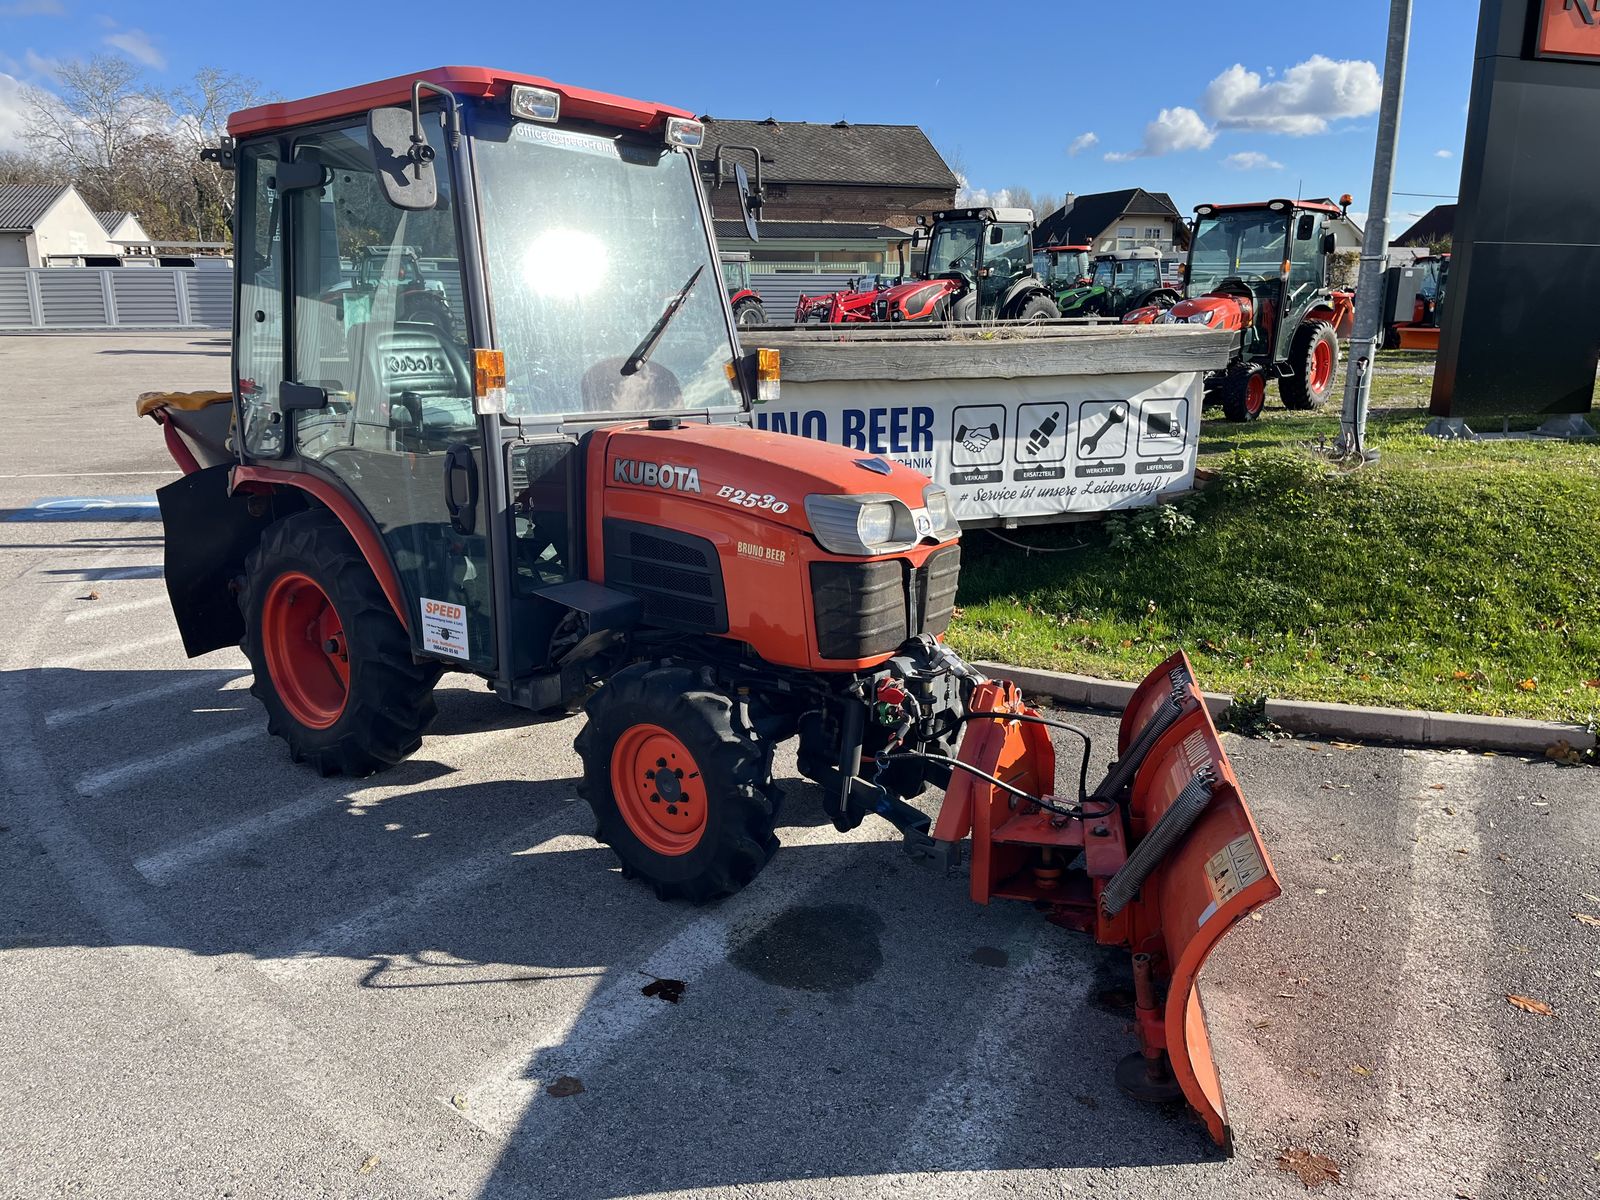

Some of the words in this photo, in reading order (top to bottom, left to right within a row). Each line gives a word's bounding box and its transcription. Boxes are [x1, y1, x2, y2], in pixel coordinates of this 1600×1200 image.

[842, 406, 935, 454] BEER
[614, 458, 700, 493] KUBOTA
[716, 485, 789, 514] B2530
[960, 493, 969, 501] #
[973, 486, 1018, 502] Service
[1020, 485, 1036, 499] ist
[1037, 486, 1078, 498] unsere
[737, 541, 763, 558] BRUNO
[765, 547, 786, 562] BEER
[425, 601, 462, 619] SPEED
[1182, 728, 1210, 767] BRUNO
